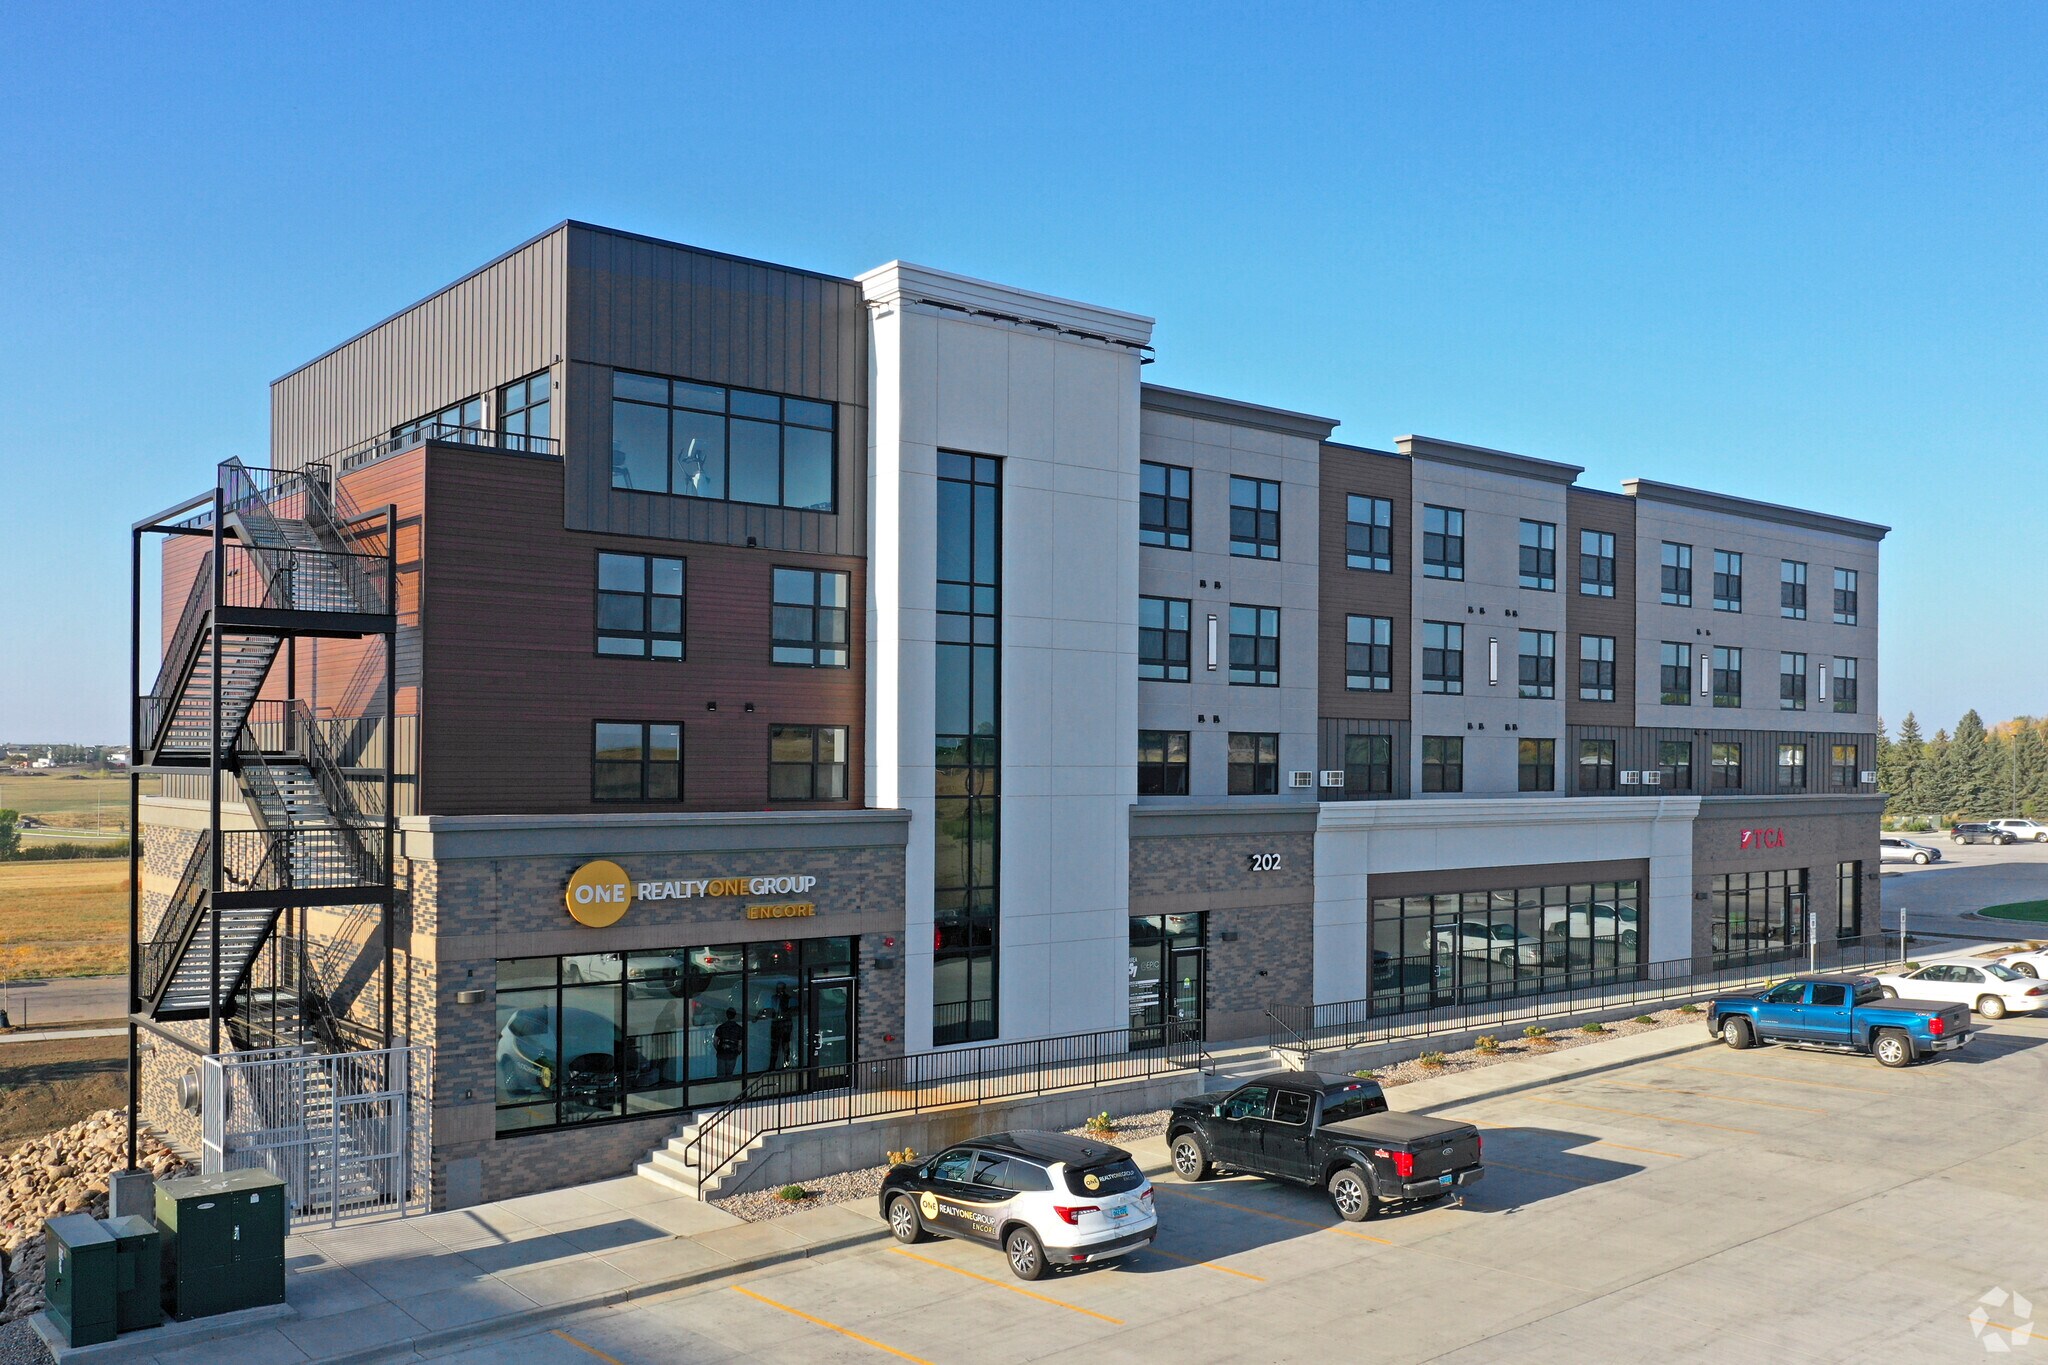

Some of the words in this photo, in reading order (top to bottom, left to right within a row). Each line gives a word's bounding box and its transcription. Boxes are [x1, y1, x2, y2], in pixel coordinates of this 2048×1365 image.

[1252, 853, 1281, 871] 202
[575, 884, 625, 904] ONE
[750, 905, 816, 920] ENCORE
[922, 1200, 937, 1210] ONE
[972, 1223, 995, 1235] ENCORE
